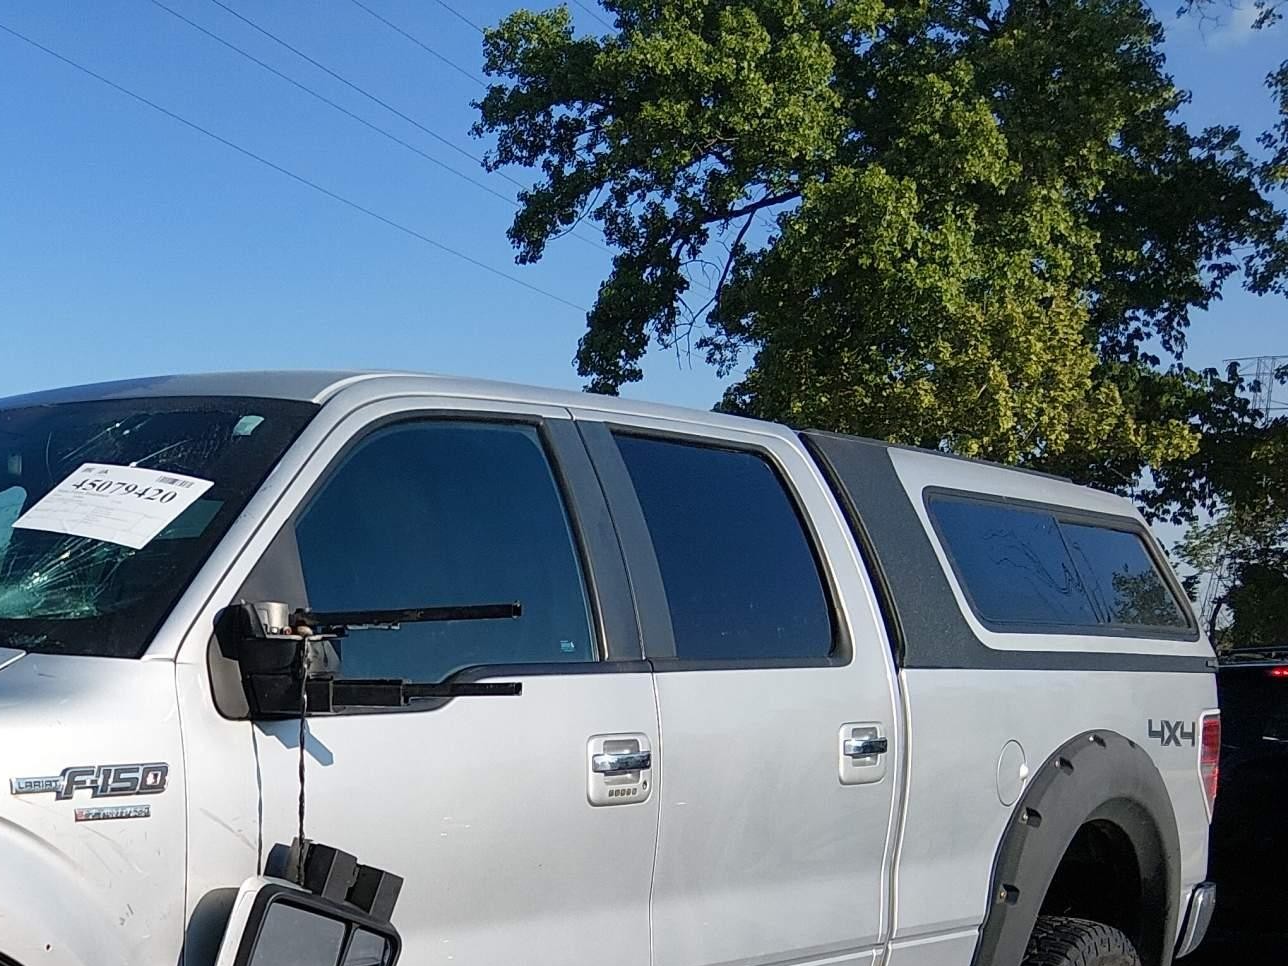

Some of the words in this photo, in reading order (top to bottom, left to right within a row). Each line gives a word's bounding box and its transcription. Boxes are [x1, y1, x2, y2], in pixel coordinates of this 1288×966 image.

[72, 477, 178, 505] 45079420
[16, 779, 61, 791] LARIAT
[55, 762, 170, 801] F-150
